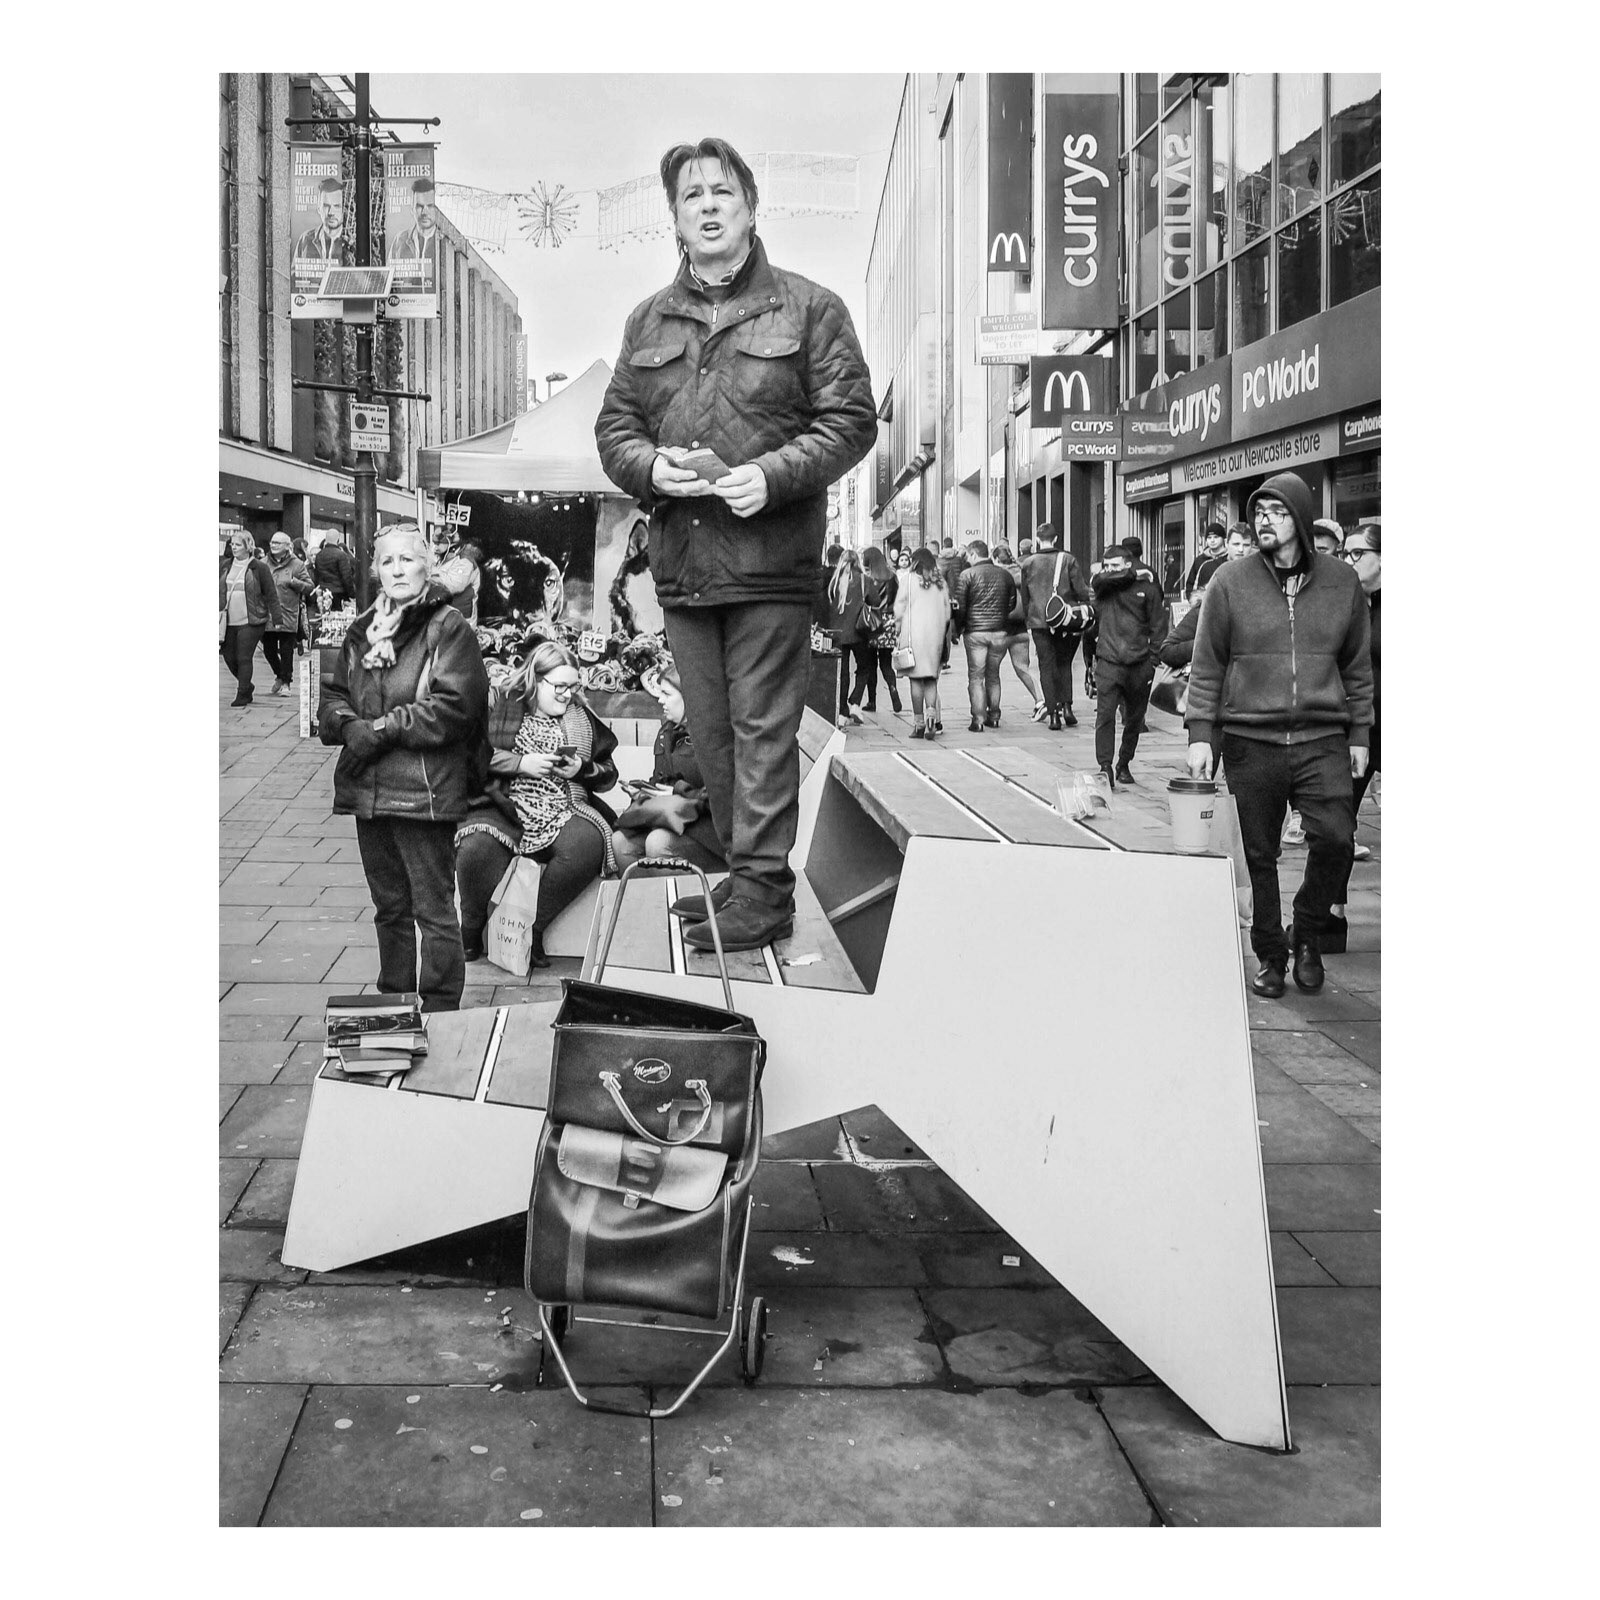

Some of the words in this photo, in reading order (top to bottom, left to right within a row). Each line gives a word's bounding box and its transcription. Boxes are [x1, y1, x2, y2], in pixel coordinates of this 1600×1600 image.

[295, 151, 312, 164] JIM
[388, 153, 404, 165] JIM
[294, 164, 338, 176] JEFFERIES
[387, 164, 431, 178] JEFFERIES
[1063, 133, 1109, 287] currys
[983, 315, 1009, 325] SMITH
[514, 340, 525, 391] Sainsbury's
[1242, 366, 1266, 413] PC
[1267, 343, 1320, 404] World
[516, 393, 525, 415] Loca
[1169, 383, 1221, 441] currys
[1070, 420, 1114, 435] currys
[1067, 444, 1084, 455] PC
[1084, 444, 1117, 455] World
[1183, 460, 1217, 483] Welcome
[1218, 455, 1227, 474] to
[1229, 454, 1243, 472] our
[1244, 436, 1292, 468] Newcastle
[1294, 432, 1320, 456] store
[449, 510, 468, 522] £15
[584, 636, 603, 649] £15
[497, 932, 519, 946] LEWI
